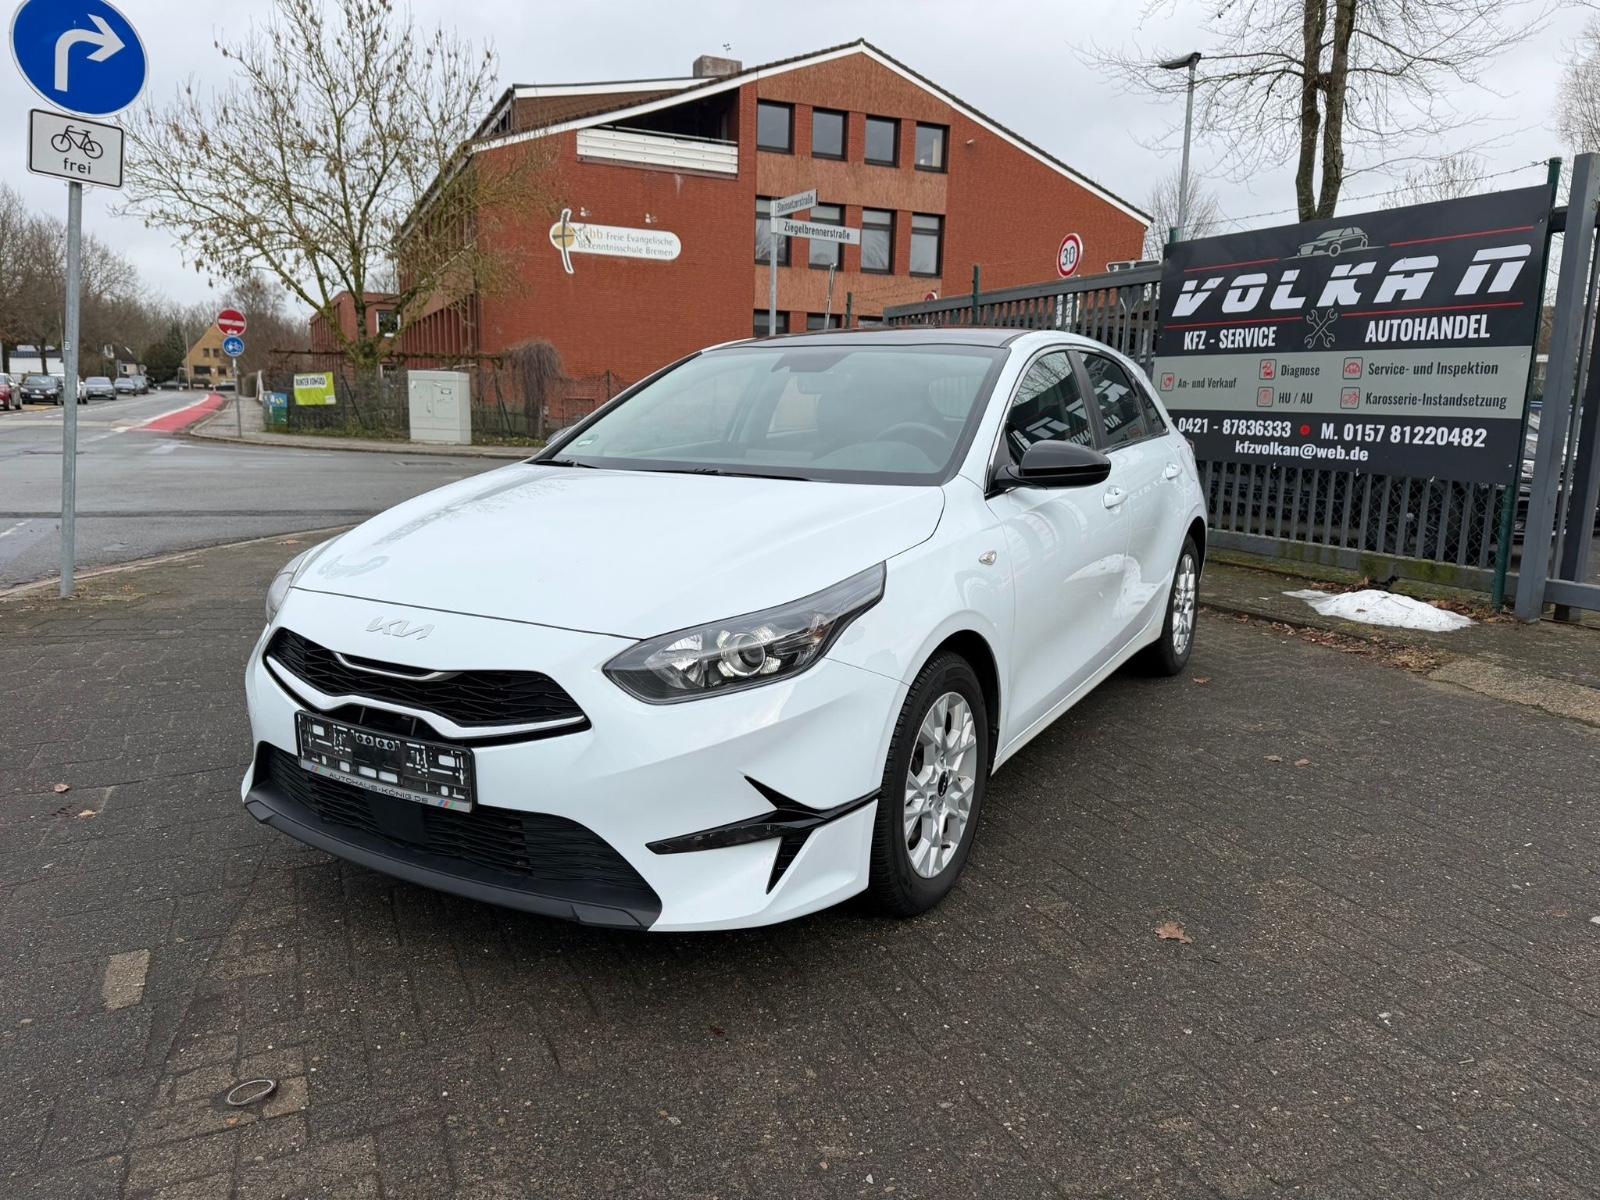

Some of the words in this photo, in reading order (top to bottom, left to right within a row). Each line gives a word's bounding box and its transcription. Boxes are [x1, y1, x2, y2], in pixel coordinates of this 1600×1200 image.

[63, 157, 91, 174] frei
[626, 233, 673, 247] Evangelische
[784, 221, 850, 240] Ziegelbrennerstraße
[645, 246, 674, 257] Bremen
[1062, 245, 1076, 266] 30
[1172, 244, 1532, 318] VOLKAN
[1183, 330, 1207, 351] KFZ
[1219, 326, 1278, 350] SERVICE
[1364, 314, 1491, 344] AUTOHANDEL
[1280, 364, 1321, 378] Diagnose
[1368, 362, 1410, 376] Service-
[1413, 363, 1433, 376] und
[1436, 361, 1499, 378] Inspektion
[1177, 378, 1190, 389] An-
[1191, 378, 1206, 389] und
[1207, 377, 1237, 389] Verkauf
[1278, 392, 1291, 404] HU
[1300, 392, 1313, 404] AU
[1365, 391, 1507, 410] Karosserie-Instandsetzung
[1178, 417, 1209, 434] 0421
[1222, 418, 1292, 438] 87836333
[1320, 422, 1339, 441] M.
[1343, 423, 1385, 443] 0157
[1390, 425, 1488, 449] 81220482
[1235, 440, 1369, 462] kfzvolkan@web.de
